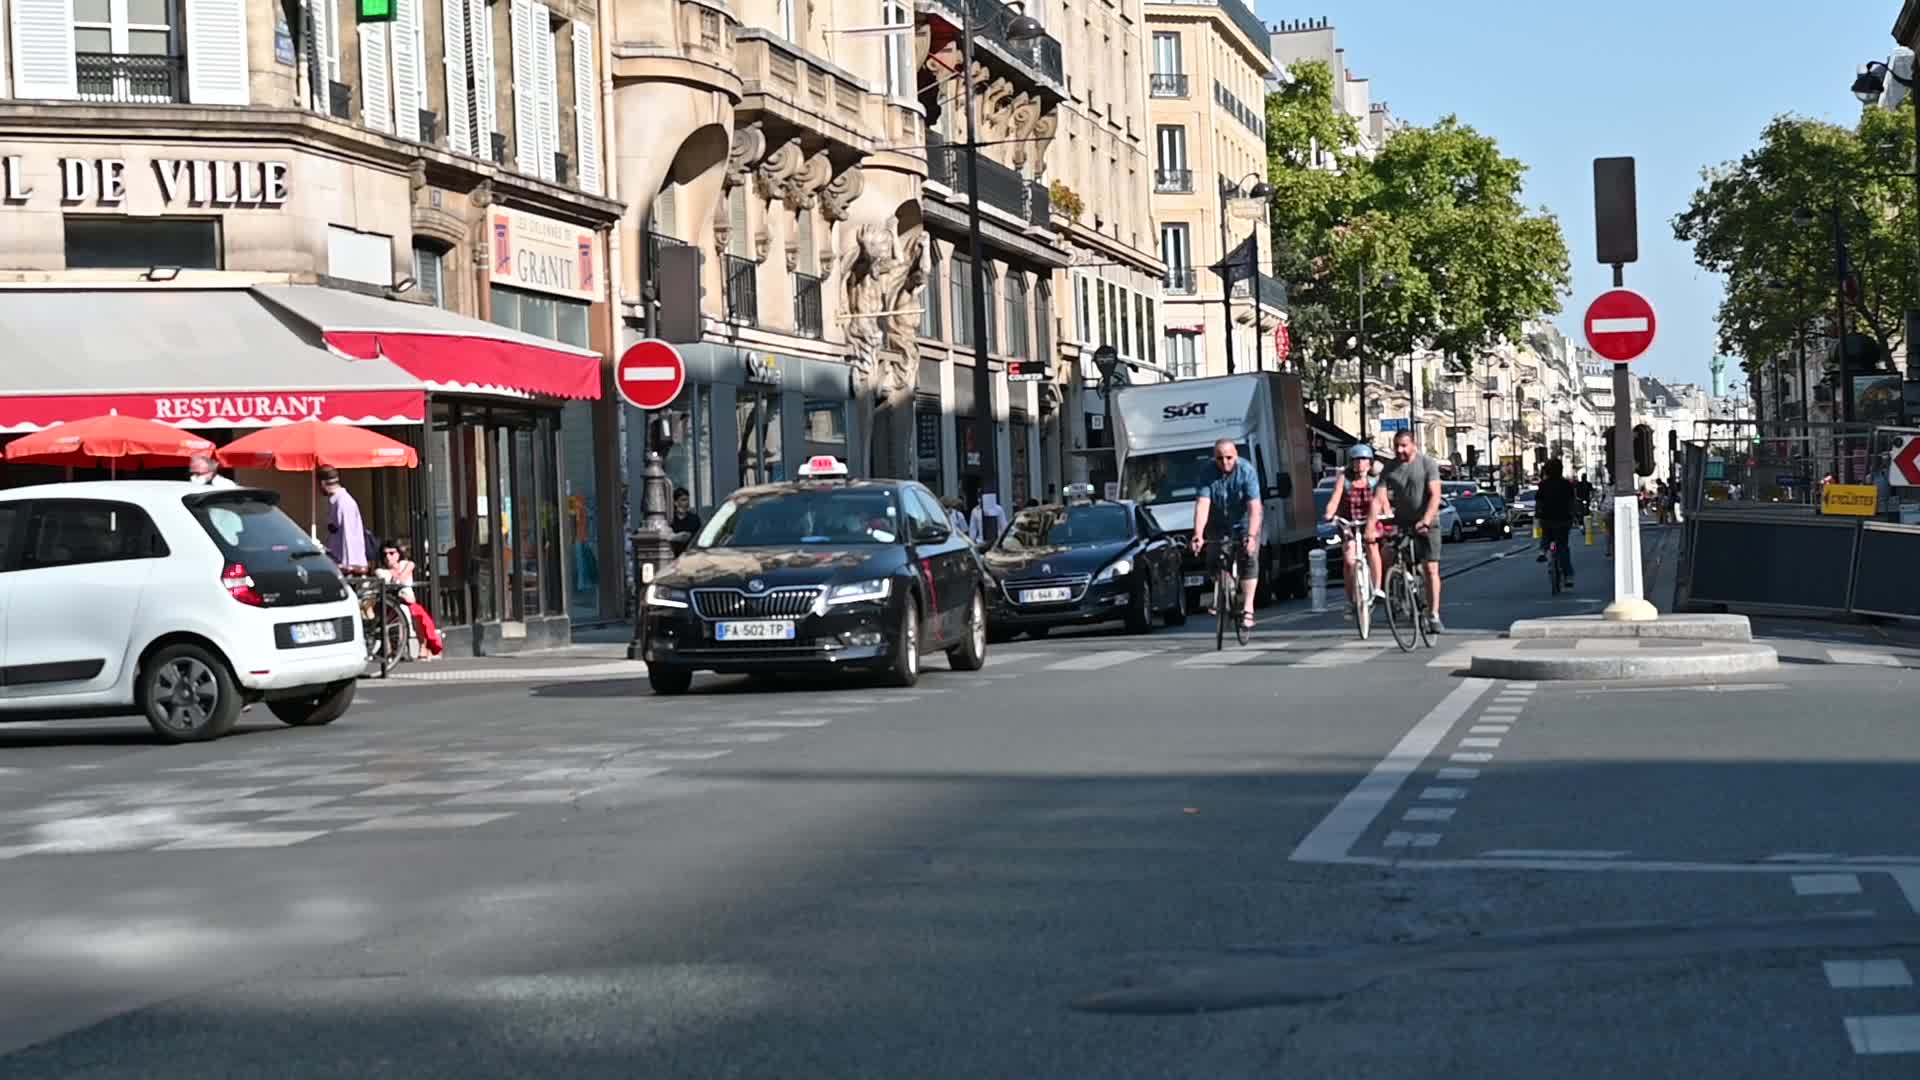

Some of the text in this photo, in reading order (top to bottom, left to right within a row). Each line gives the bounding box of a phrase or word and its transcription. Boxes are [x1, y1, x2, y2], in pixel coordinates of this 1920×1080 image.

[58, 157, 127, 207] DE
[150, 158, 289, 209] VILLE
[517, 248, 574, 291] GRANIT
[154, 395, 327, 419] RESTAURANT
[1163, 402, 1209, 419] SIXT
